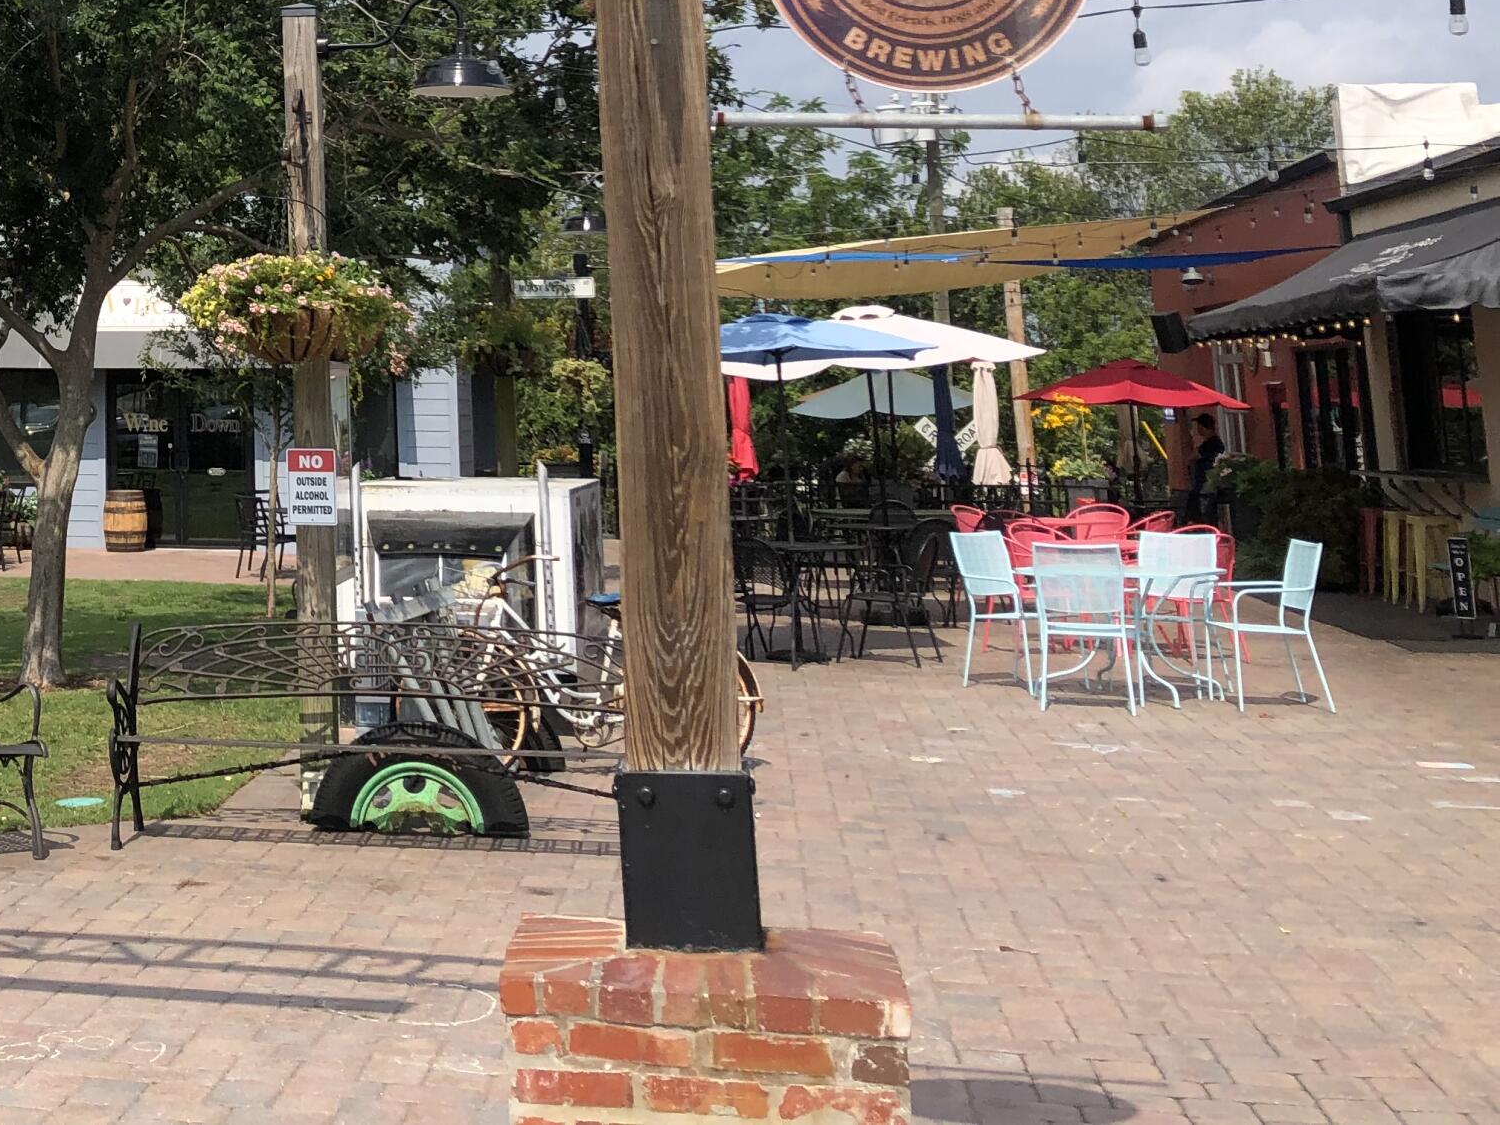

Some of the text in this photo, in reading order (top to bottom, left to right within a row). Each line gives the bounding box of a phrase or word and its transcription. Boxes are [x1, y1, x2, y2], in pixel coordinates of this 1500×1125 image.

[841, 26, 1014, 71] BREWING
[122, 412, 241, 433] Wine Down
[956, 427, 977, 449] ROA
[298, 454, 323, 469] NO
[296, 476, 327, 486] OUTSIDE
[295, 491, 329, 500] ALCOHOL
[292, 505, 332, 514] PERMITTED
[1454, 557, 1469, 611] OPEN
